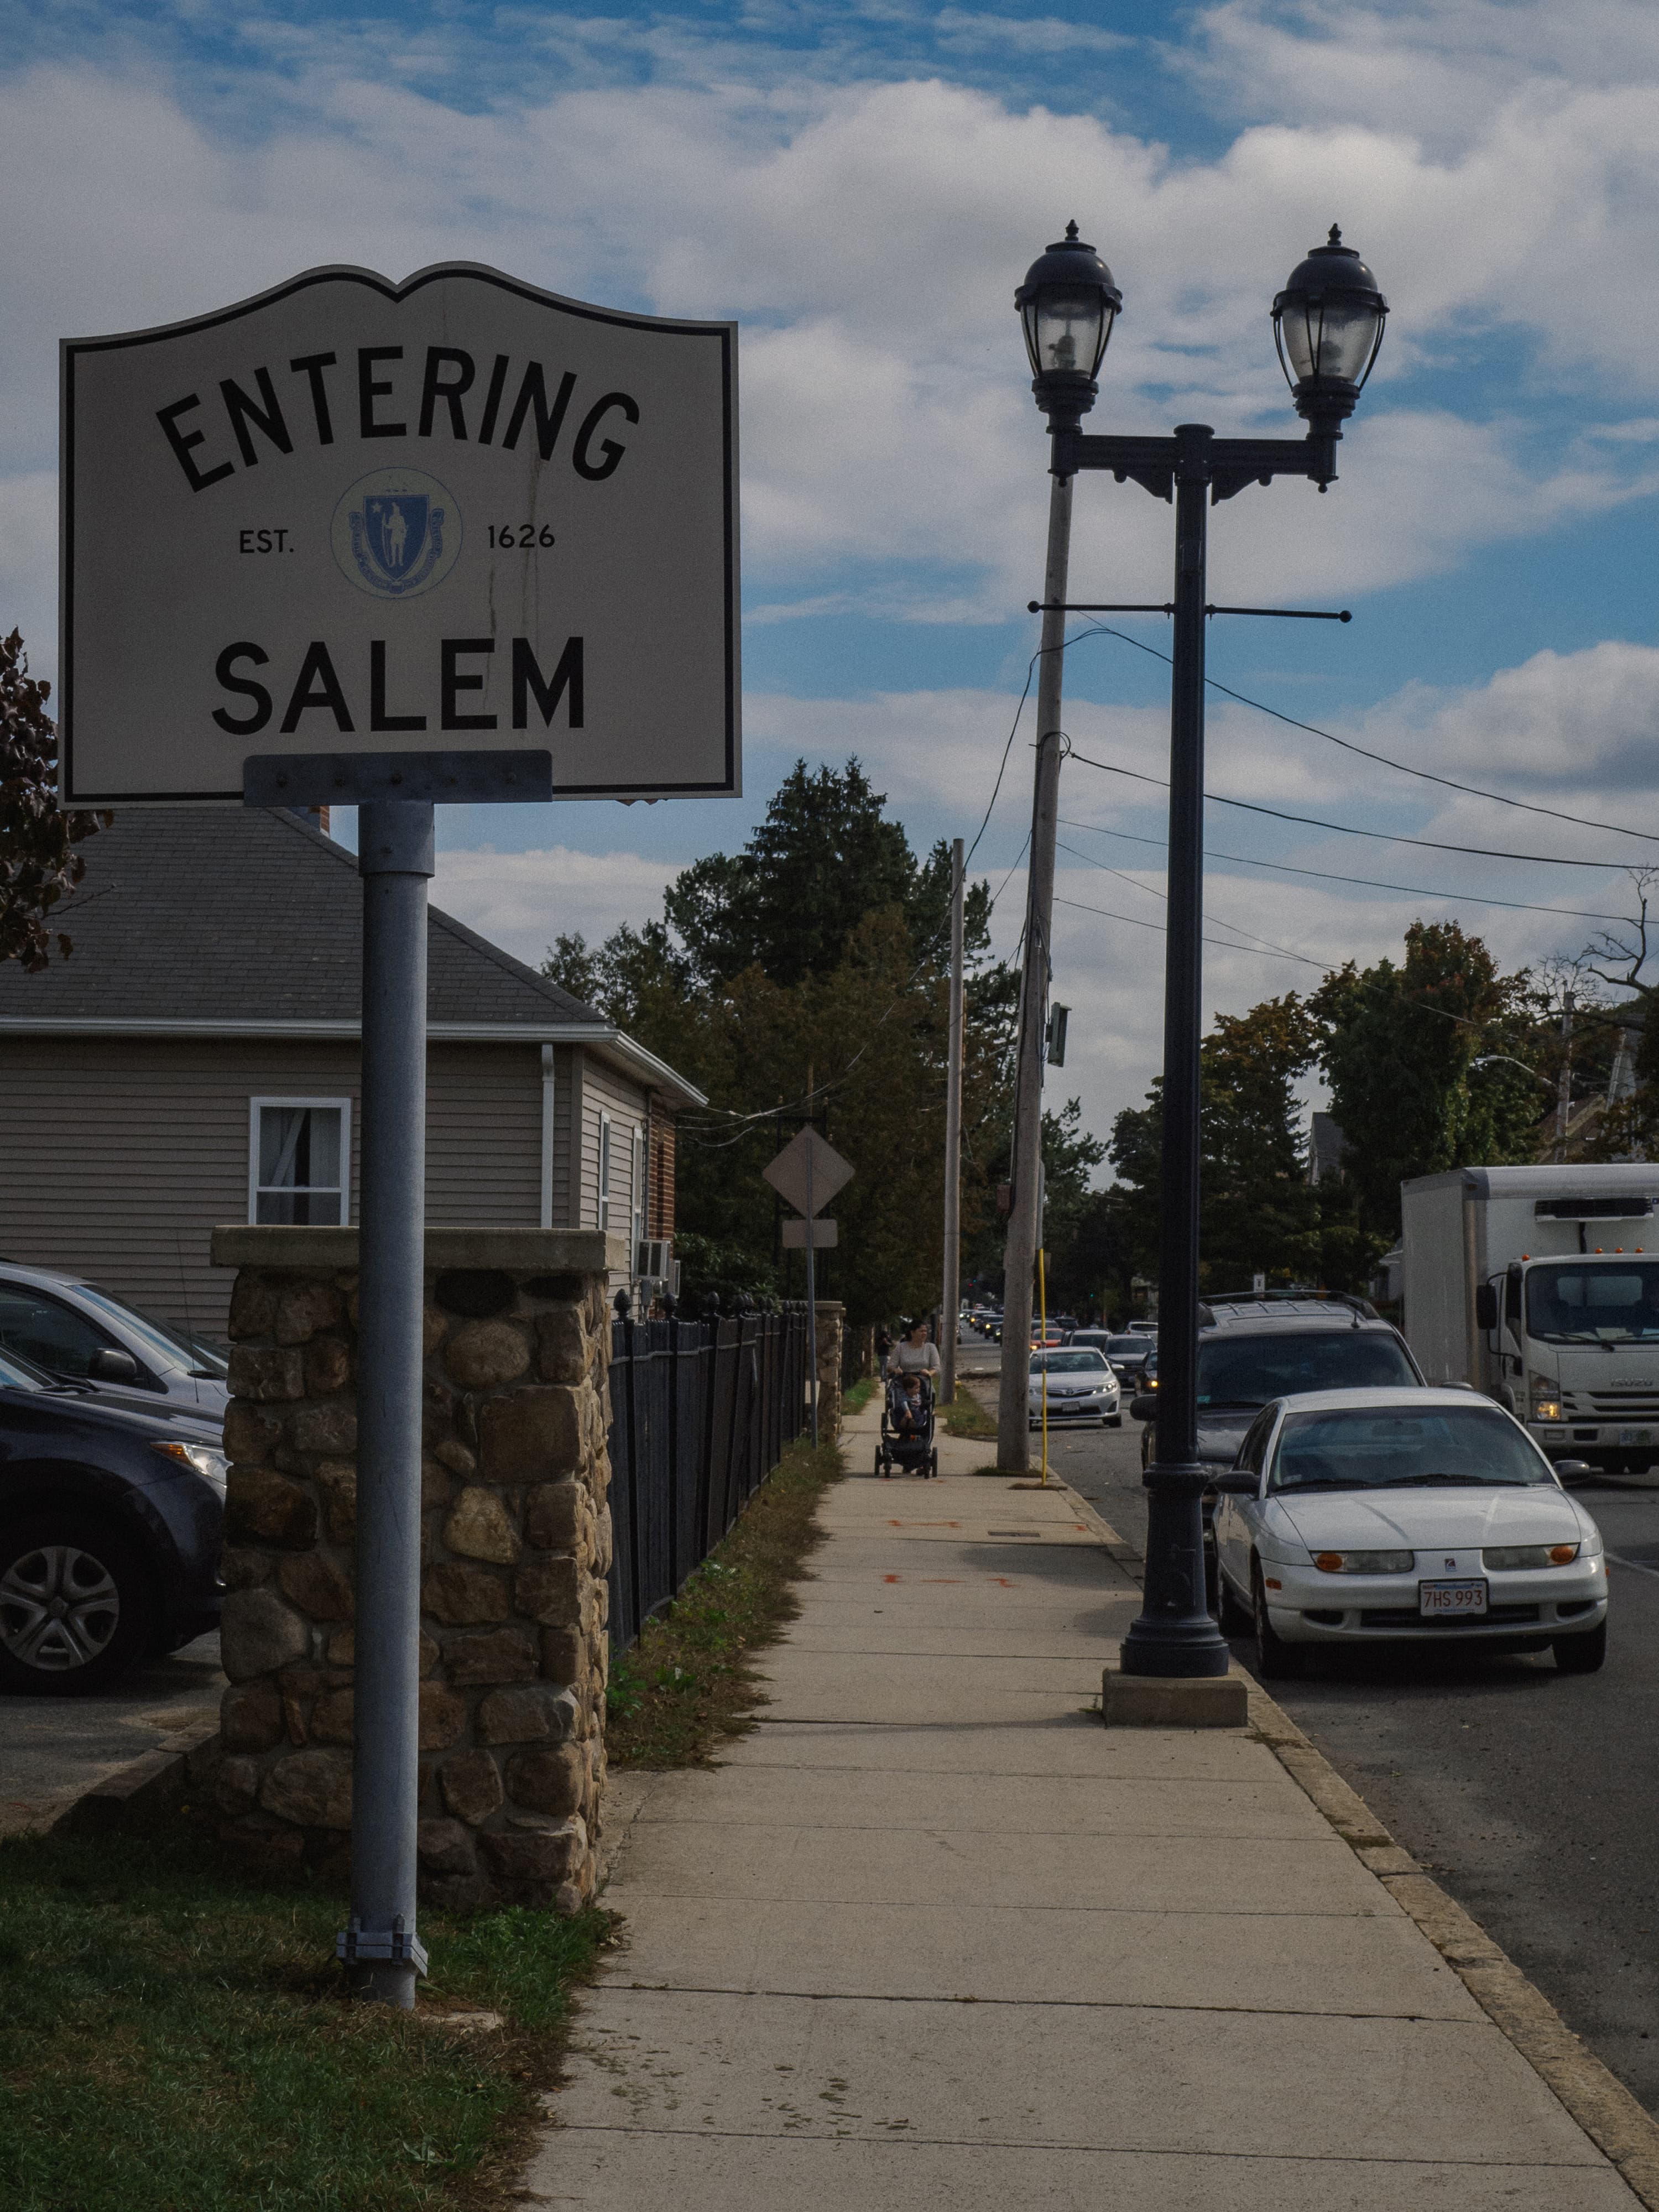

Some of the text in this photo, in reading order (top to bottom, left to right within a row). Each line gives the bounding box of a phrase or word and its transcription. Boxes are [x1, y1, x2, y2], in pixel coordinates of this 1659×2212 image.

[156, 346, 640, 493] ENTERING
[239, 524, 556, 554] EST. 1626
[211, 637, 584, 735] SALEM
[1455, 1590, 1483, 1606] 993
